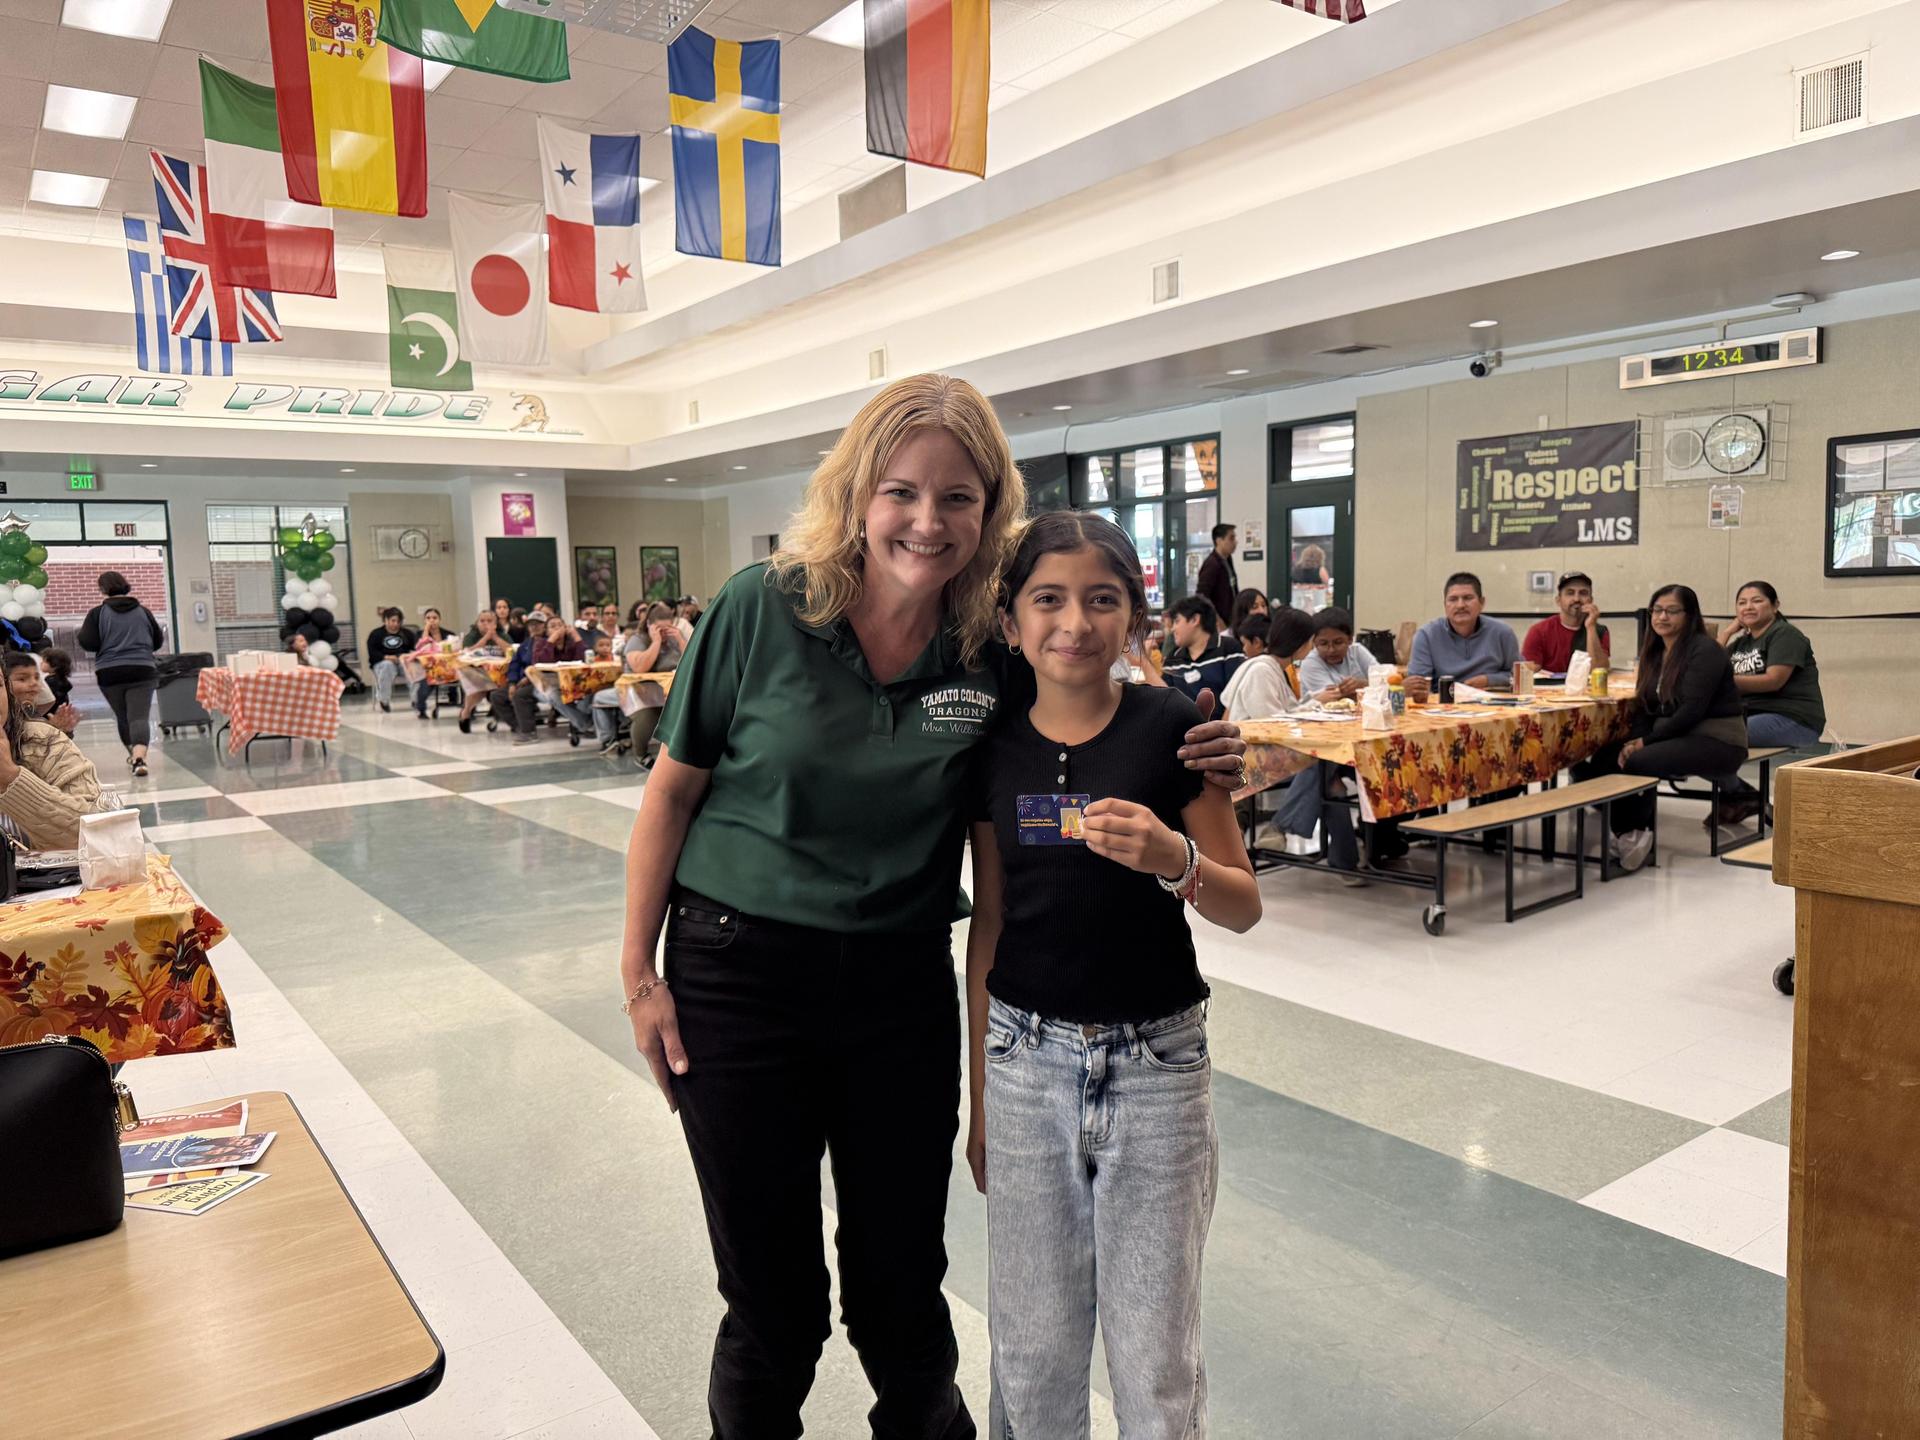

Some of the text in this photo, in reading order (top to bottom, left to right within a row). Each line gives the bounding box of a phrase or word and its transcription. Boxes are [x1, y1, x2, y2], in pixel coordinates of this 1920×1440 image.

[223, 382, 489, 420] PRIDE
[70, 475, 95, 490] EXIT
[1492, 460, 1637, 501] Respect
[114, 523, 137, 537] EXIT
[1577, 517, 1632, 542] LMS
[921, 689, 996, 711] YAMATO COLONY
[928, 707, 987, 718] DRAGONS
[921, 721, 946, 733] Mrs.
[160, 1179, 216, 1207] arijuana
[184, 1180, 240, 1204] Vaping
